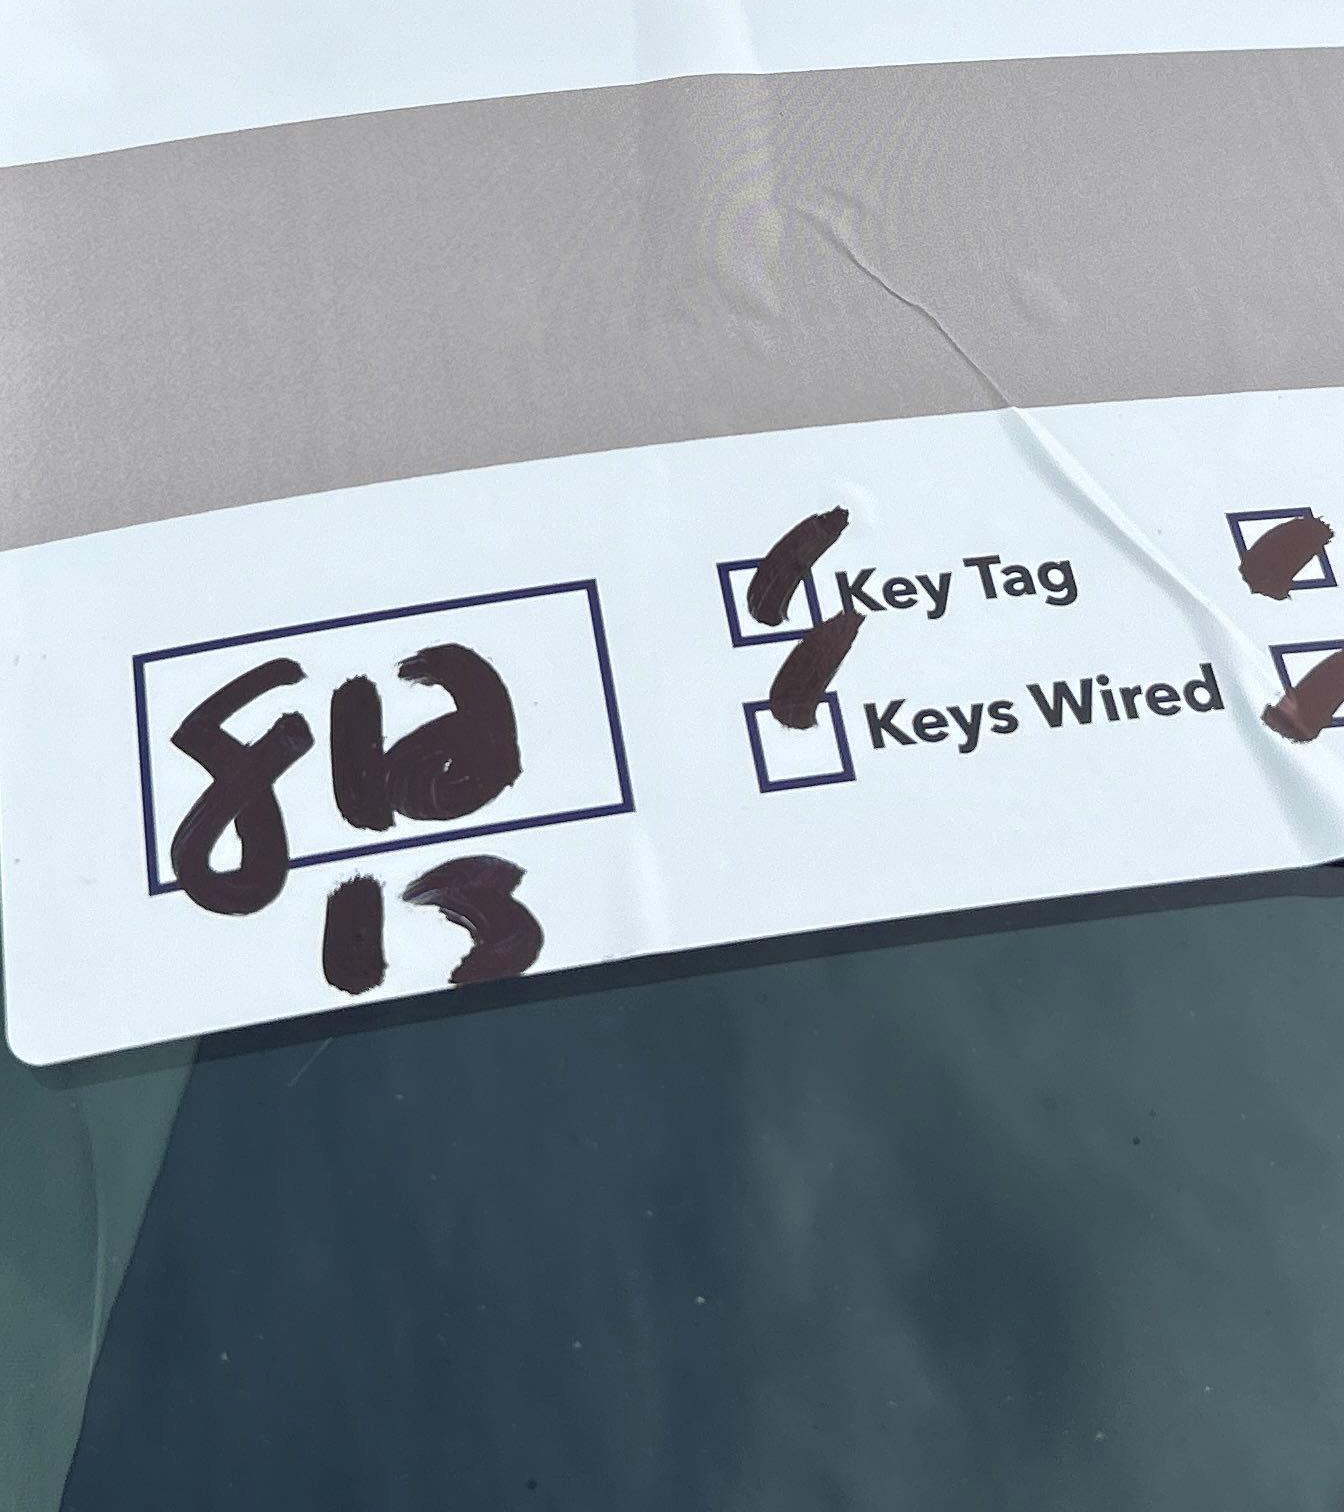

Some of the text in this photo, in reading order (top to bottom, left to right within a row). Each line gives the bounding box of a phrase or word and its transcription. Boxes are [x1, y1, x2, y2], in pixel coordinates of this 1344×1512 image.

[835, 554, 1079, 619] Key Tag
[863, 663, 1225, 754] Keys Wired
